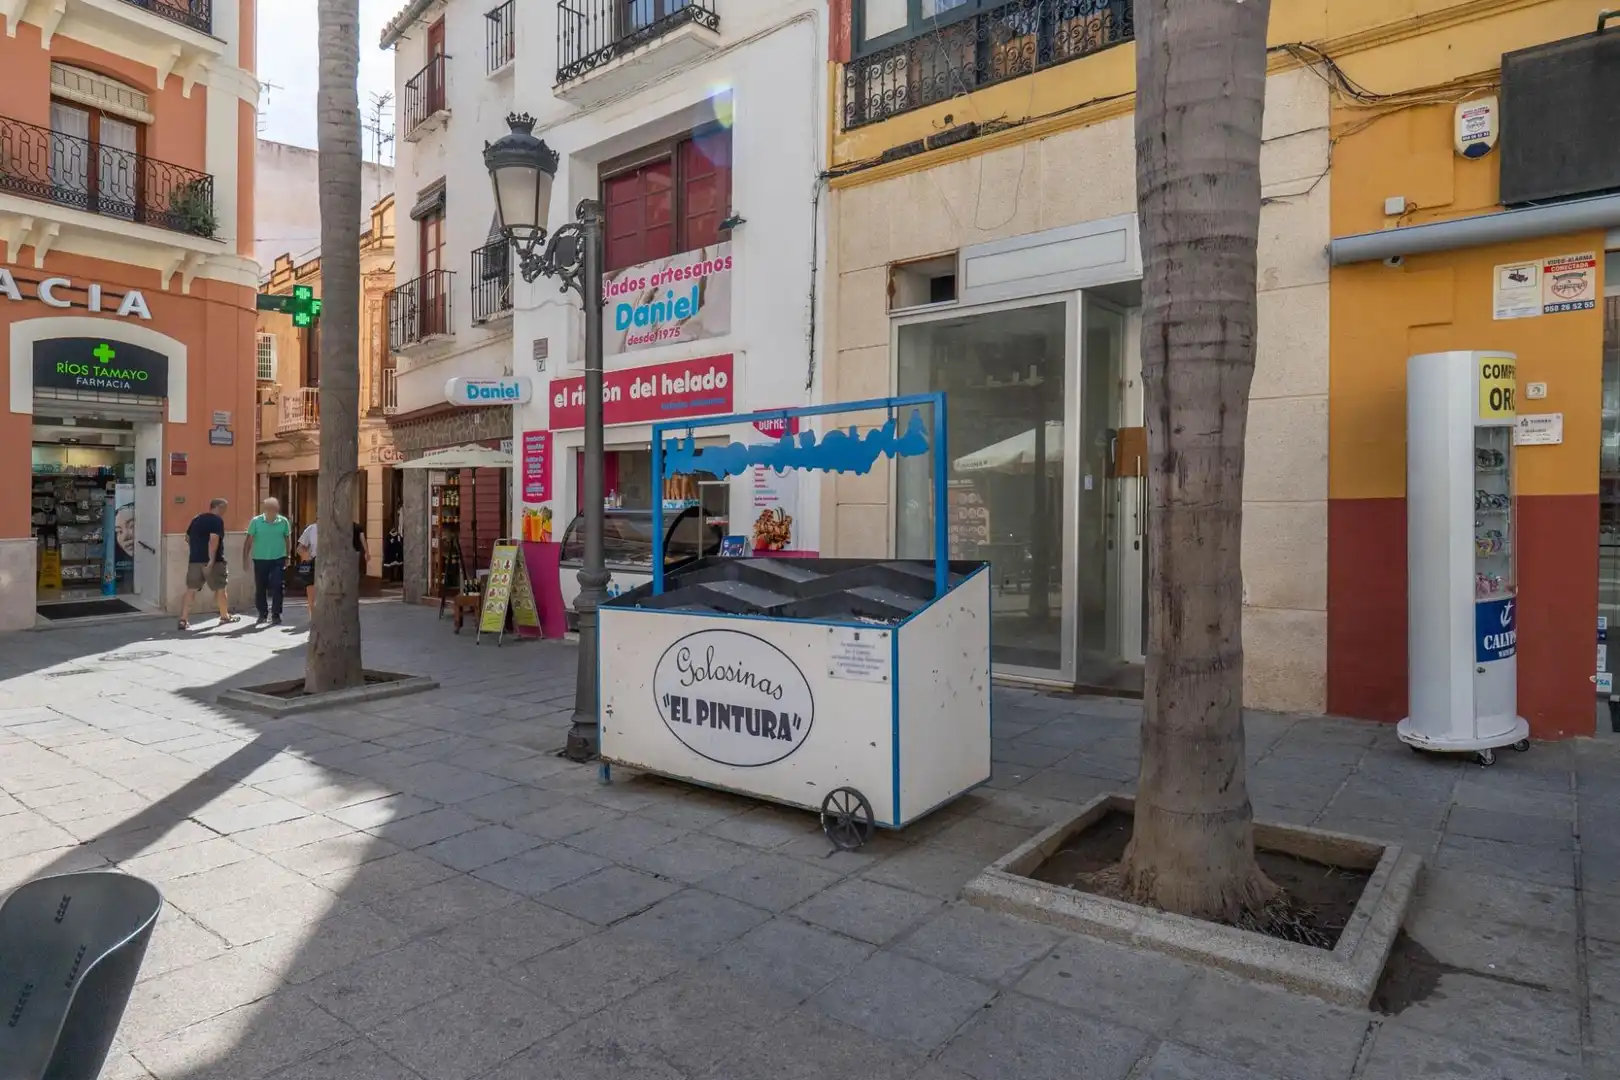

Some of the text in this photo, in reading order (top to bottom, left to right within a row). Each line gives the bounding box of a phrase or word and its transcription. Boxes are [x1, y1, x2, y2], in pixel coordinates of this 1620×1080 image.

[651, 255, 733, 287] artesanos
[615, 284, 700, 331] Daniel
[627, 327, 681, 346] desde 1975
[57, 361, 148, 380] RÍOS TAMAYO
[76, 376, 130, 389] FARMACIA
[466, 382, 520, 400] Daniel
[553, 387, 568, 408] el
[629, 374, 657, 399] del
[661, 366, 728, 395] helado
[676, 645, 783, 700] Golosinas
